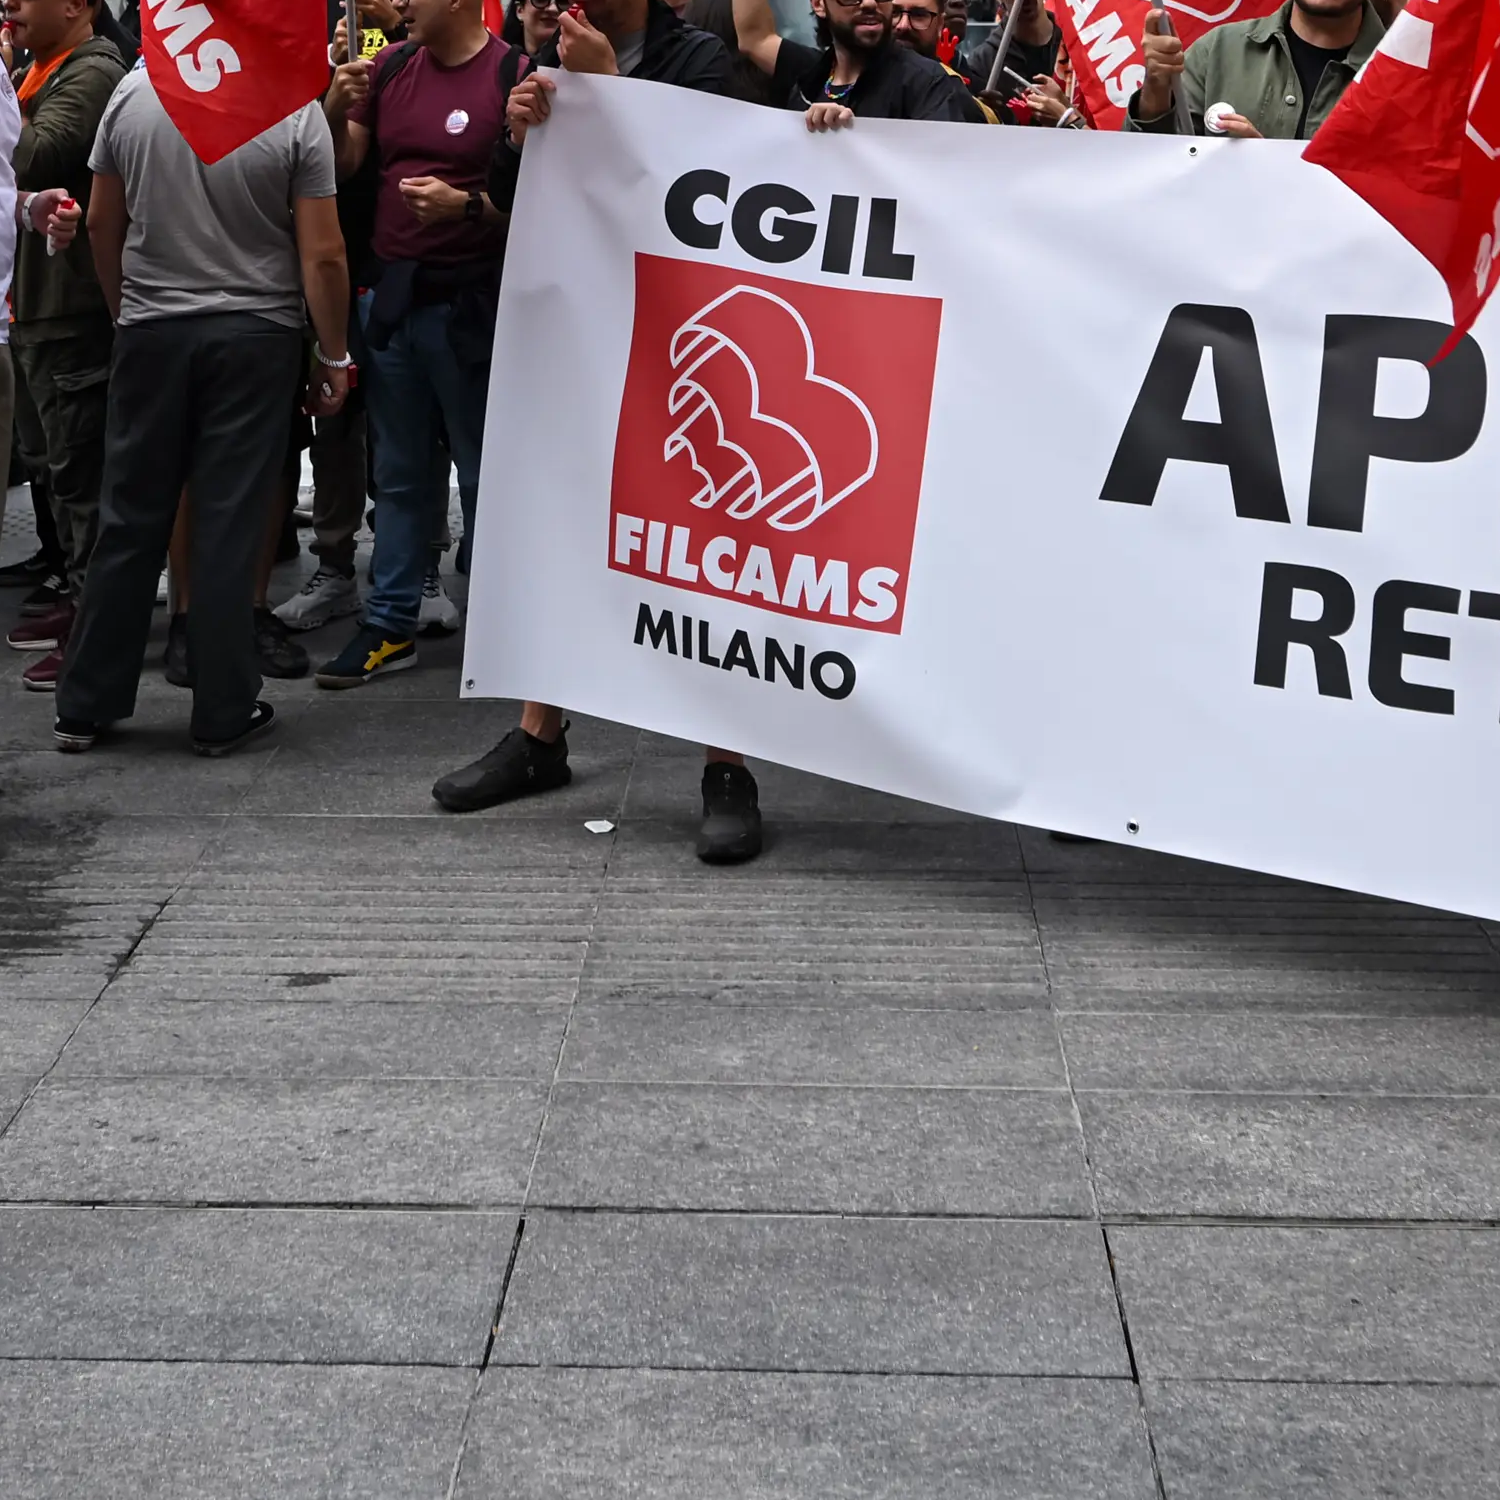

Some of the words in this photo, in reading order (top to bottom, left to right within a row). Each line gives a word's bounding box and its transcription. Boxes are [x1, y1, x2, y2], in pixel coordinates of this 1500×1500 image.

[665, 169, 915, 281] CGIL
[614, 512, 900, 622] FILCAMS
[633, 601, 857, 701] MILANO
